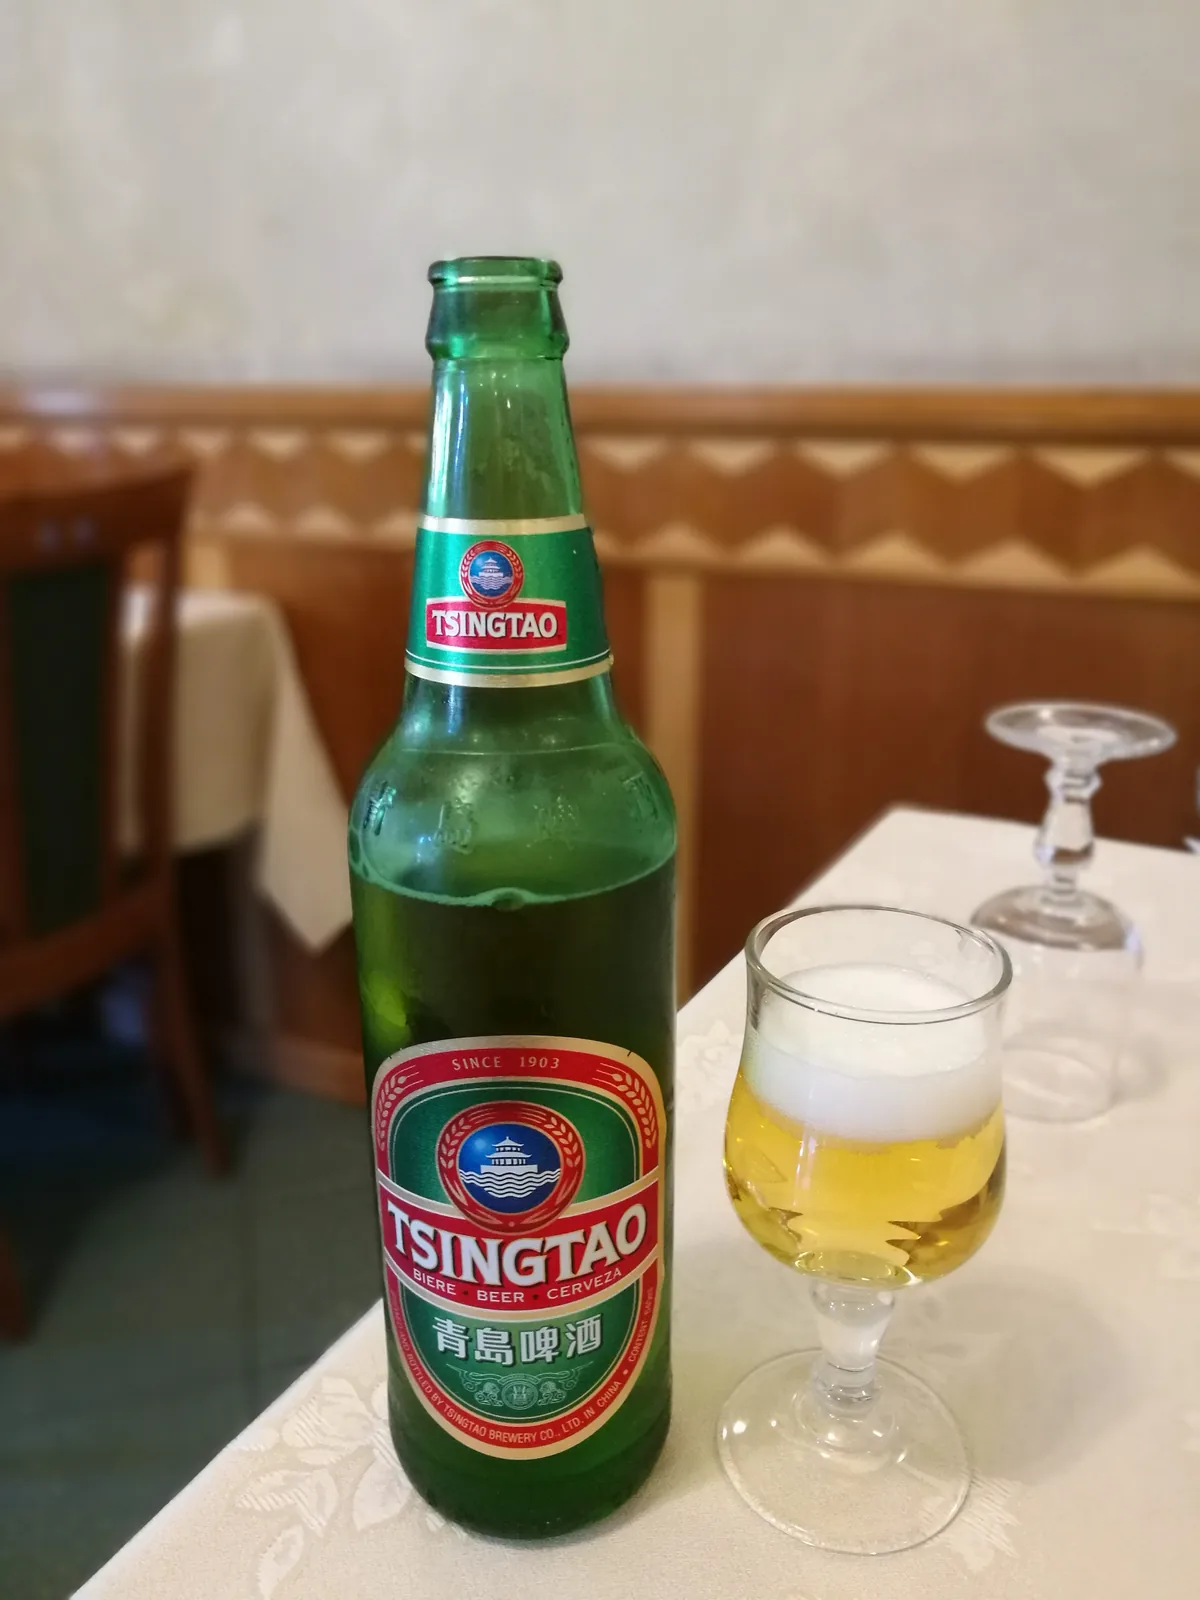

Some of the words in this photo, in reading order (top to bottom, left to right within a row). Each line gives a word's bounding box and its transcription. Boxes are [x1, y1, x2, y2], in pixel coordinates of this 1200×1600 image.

[432, 610, 558, 638] TSINGTAO
[452, 1057, 502, 1071] SINCE
[519, 1056, 561, 1069] 1903
[387, 1200, 648, 1288] TSINGTAO
[413, 1268, 457, 1296] BIERE
[476, 1290, 525, 1303] BEER
[546, 1268, 623, 1300] CERVEZA
[432, 1313, 602, 1367] 青島啤酒
[406, 1353, 433, 1394] BOTTLED
[430, 1393, 444, 1406] BY
[443, 1403, 487, 1437] TSINGTAO
[488, 1429, 538, 1444] BREWERY
[561, 1417, 585, 1433] LTD.
[583, 1407, 596, 1419] IN
[596, 1380, 622, 1408] CHINA
[628, 1320, 649, 1362] CONTENT
